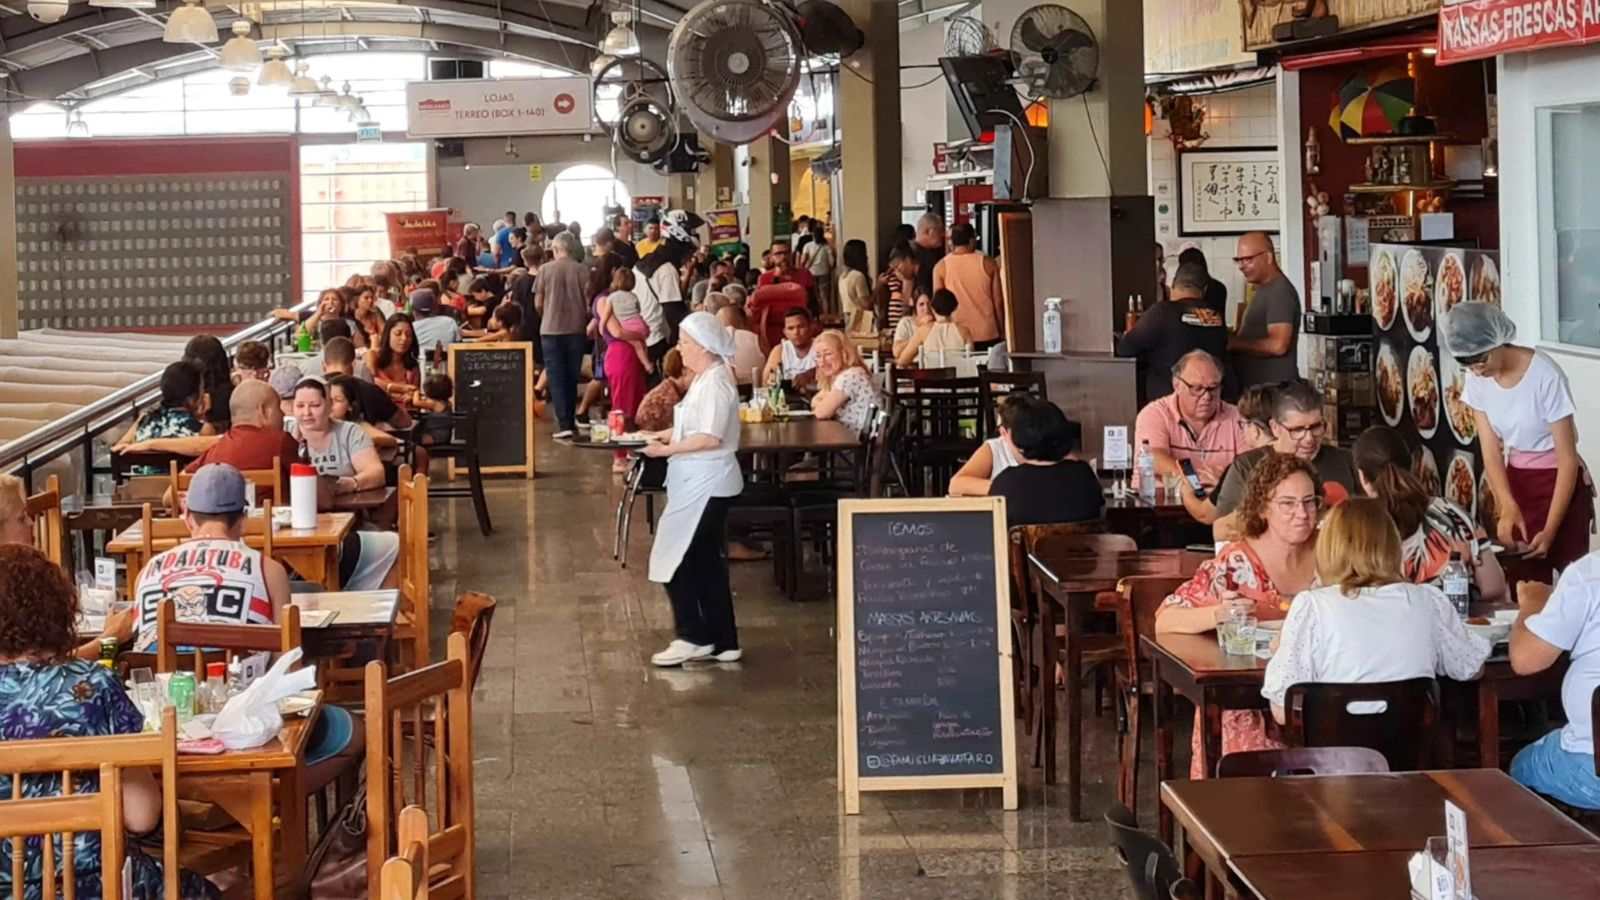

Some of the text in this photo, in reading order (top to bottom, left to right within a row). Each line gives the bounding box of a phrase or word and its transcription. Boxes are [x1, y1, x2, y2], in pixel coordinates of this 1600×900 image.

[1502, 0, 1577, 42] FRESCAS
[484, 93, 514, 103] LOJAS
[491, 108, 514, 120] (BOX
[145, 549, 252, 579] INDAIATUBA
